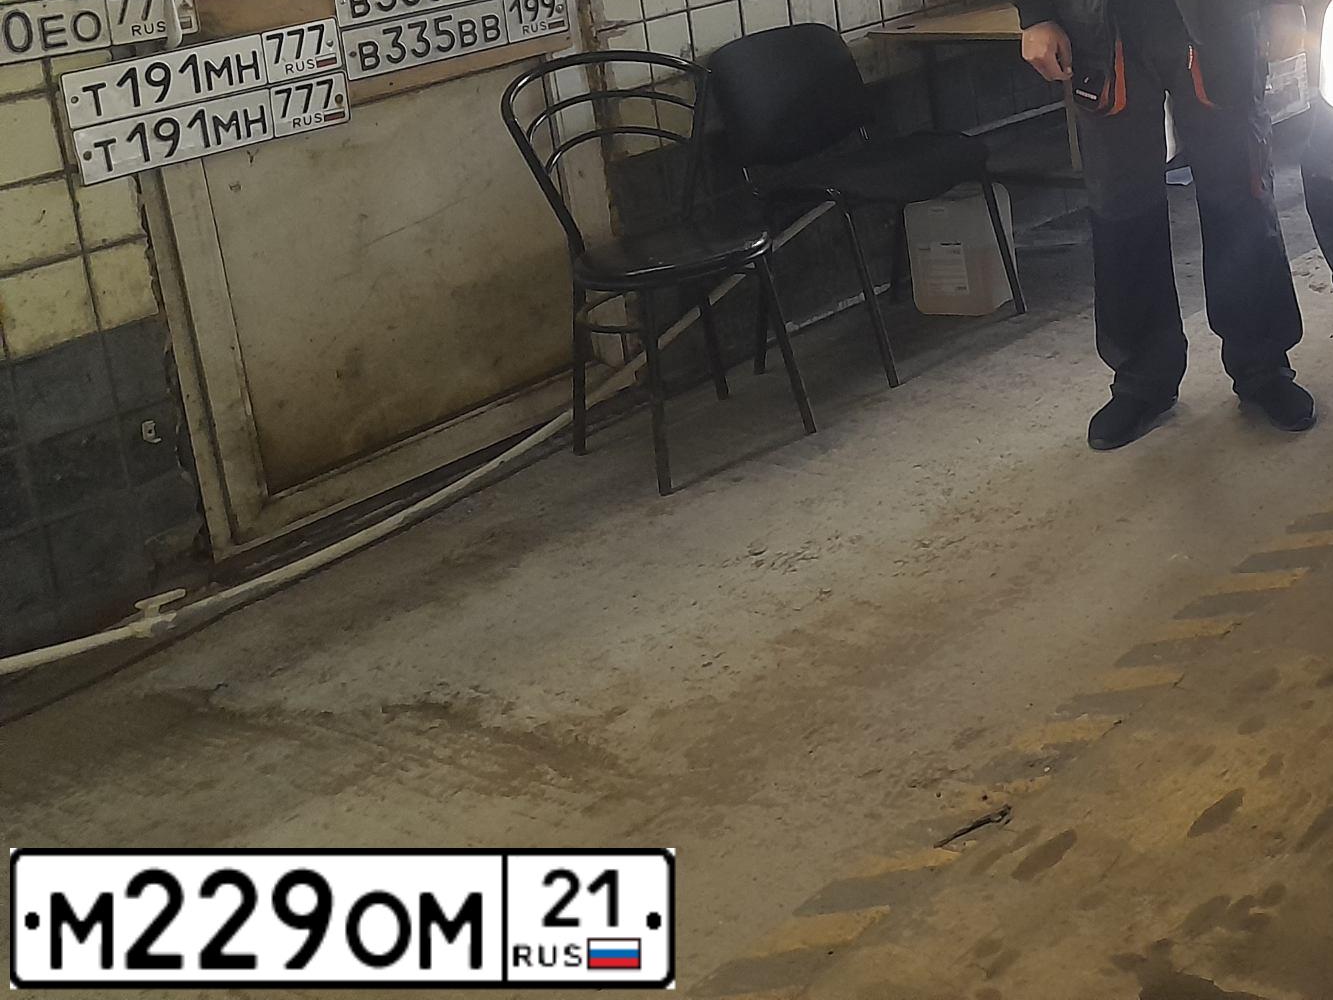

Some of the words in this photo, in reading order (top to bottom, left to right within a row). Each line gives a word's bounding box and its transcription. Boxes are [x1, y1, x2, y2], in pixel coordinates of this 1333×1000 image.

[131, 21, 166, 37] RUS
[522, 21, 548, 35] RUS
[265, 23, 325, 65] 777
[284, 59, 315, 75] RUS
[274, 78, 334, 118] 777
[292, 113, 323, 129] RUS
